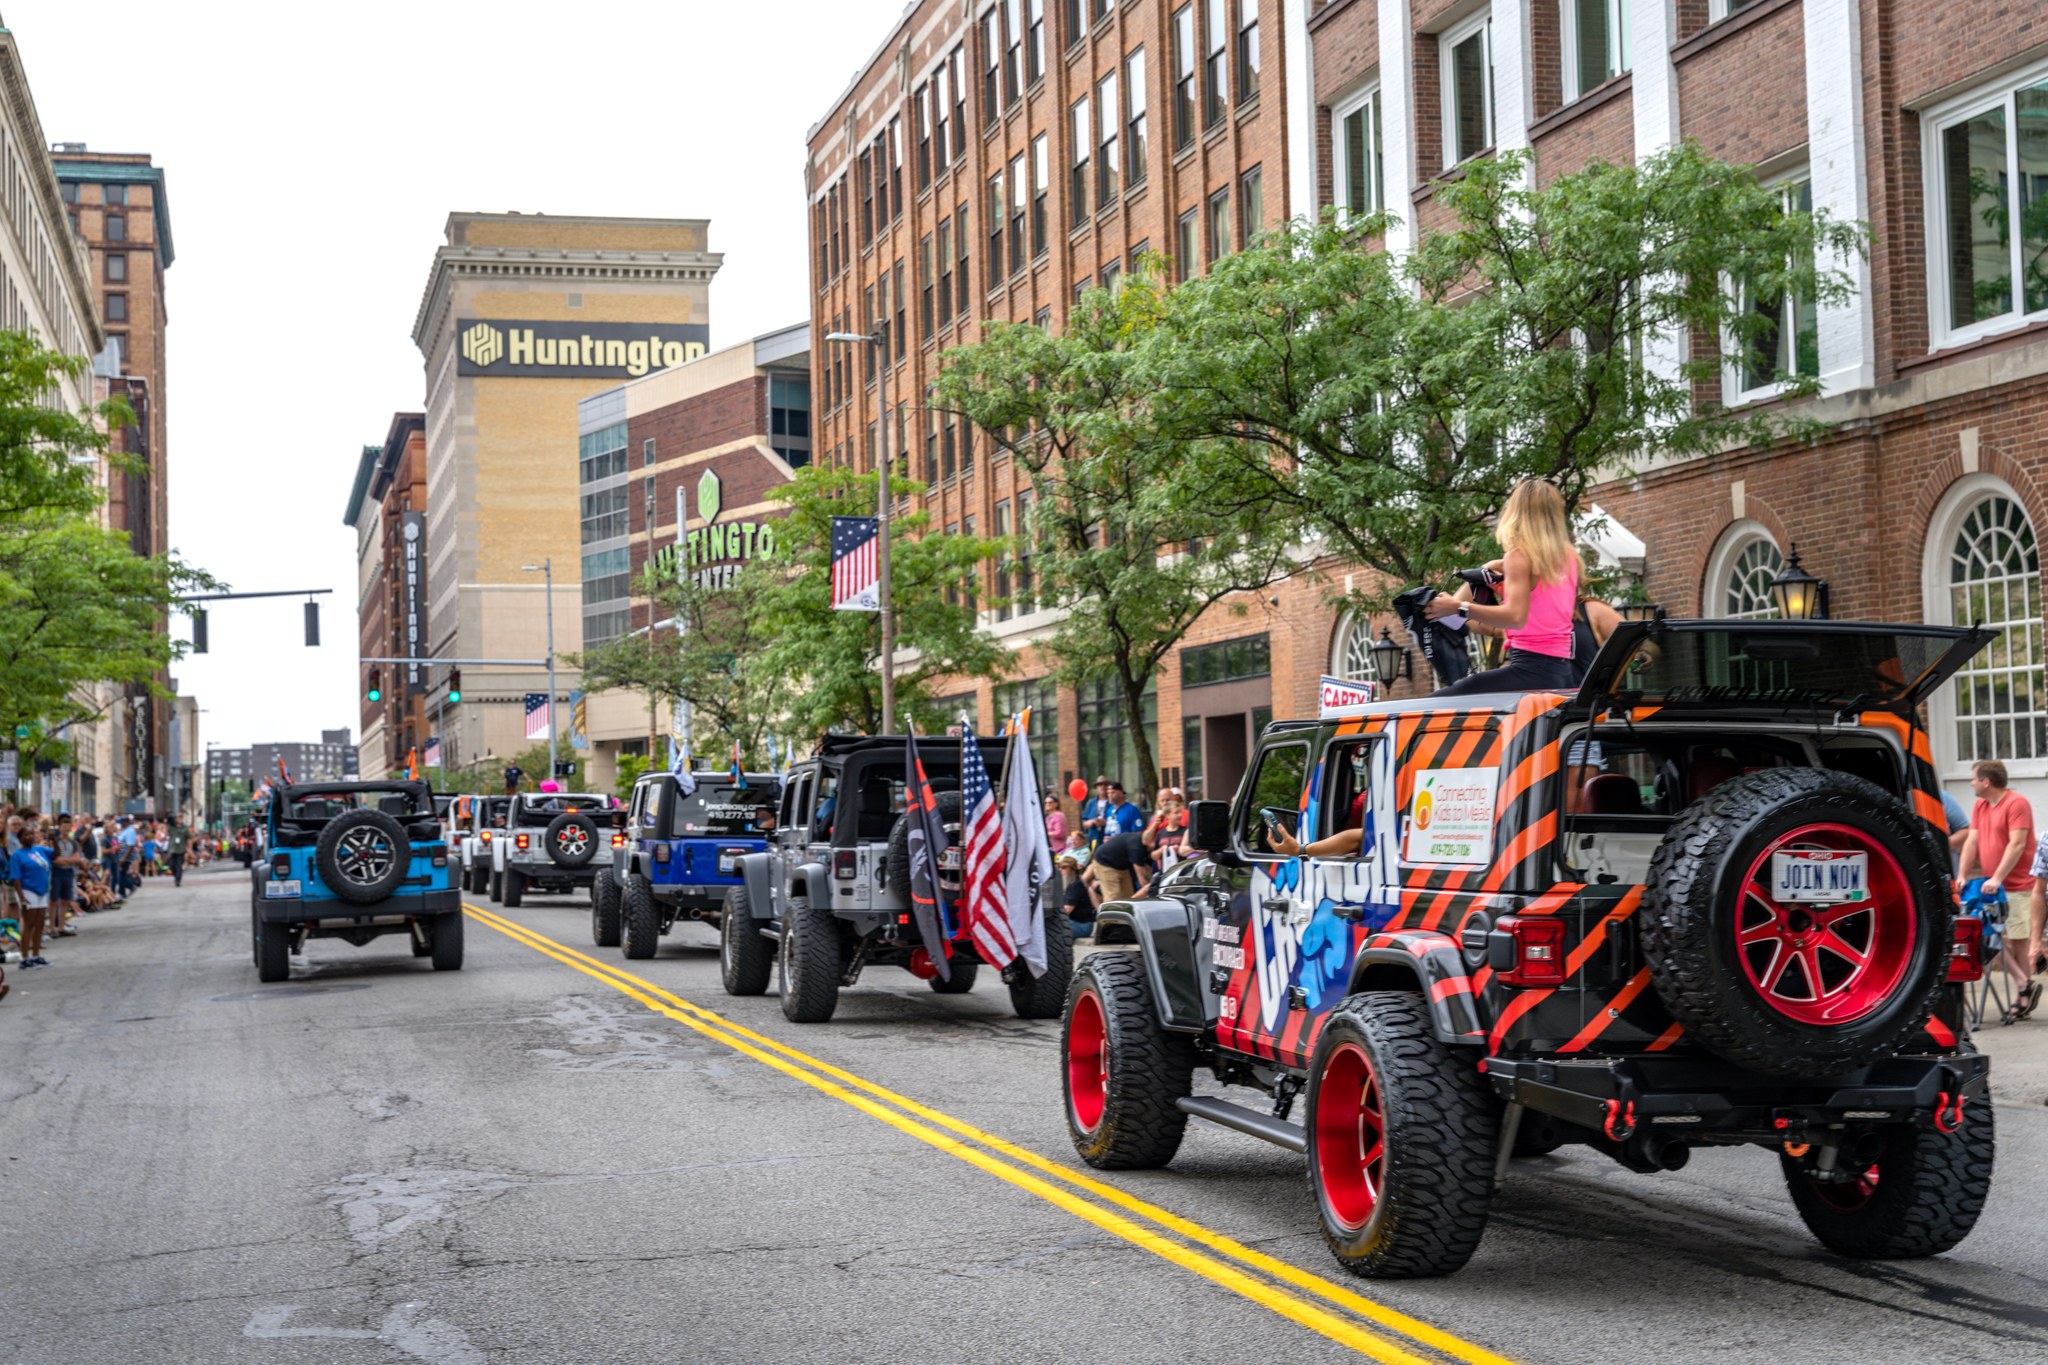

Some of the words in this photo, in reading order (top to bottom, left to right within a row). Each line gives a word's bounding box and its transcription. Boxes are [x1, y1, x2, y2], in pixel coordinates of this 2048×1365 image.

[509, 328, 706, 377] Huntington
[1436, 784, 1488, 804] Connecting
[1434, 803, 1451, 822] Kids
[1453, 806, 1463, 822] to
[1463, 803, 1491, 822] Meals
[1808, 852, 1834, 861] OHIO
[1780, 864, 1823, 890] JOIN
[1829, 864, 1861, 890] NOW
